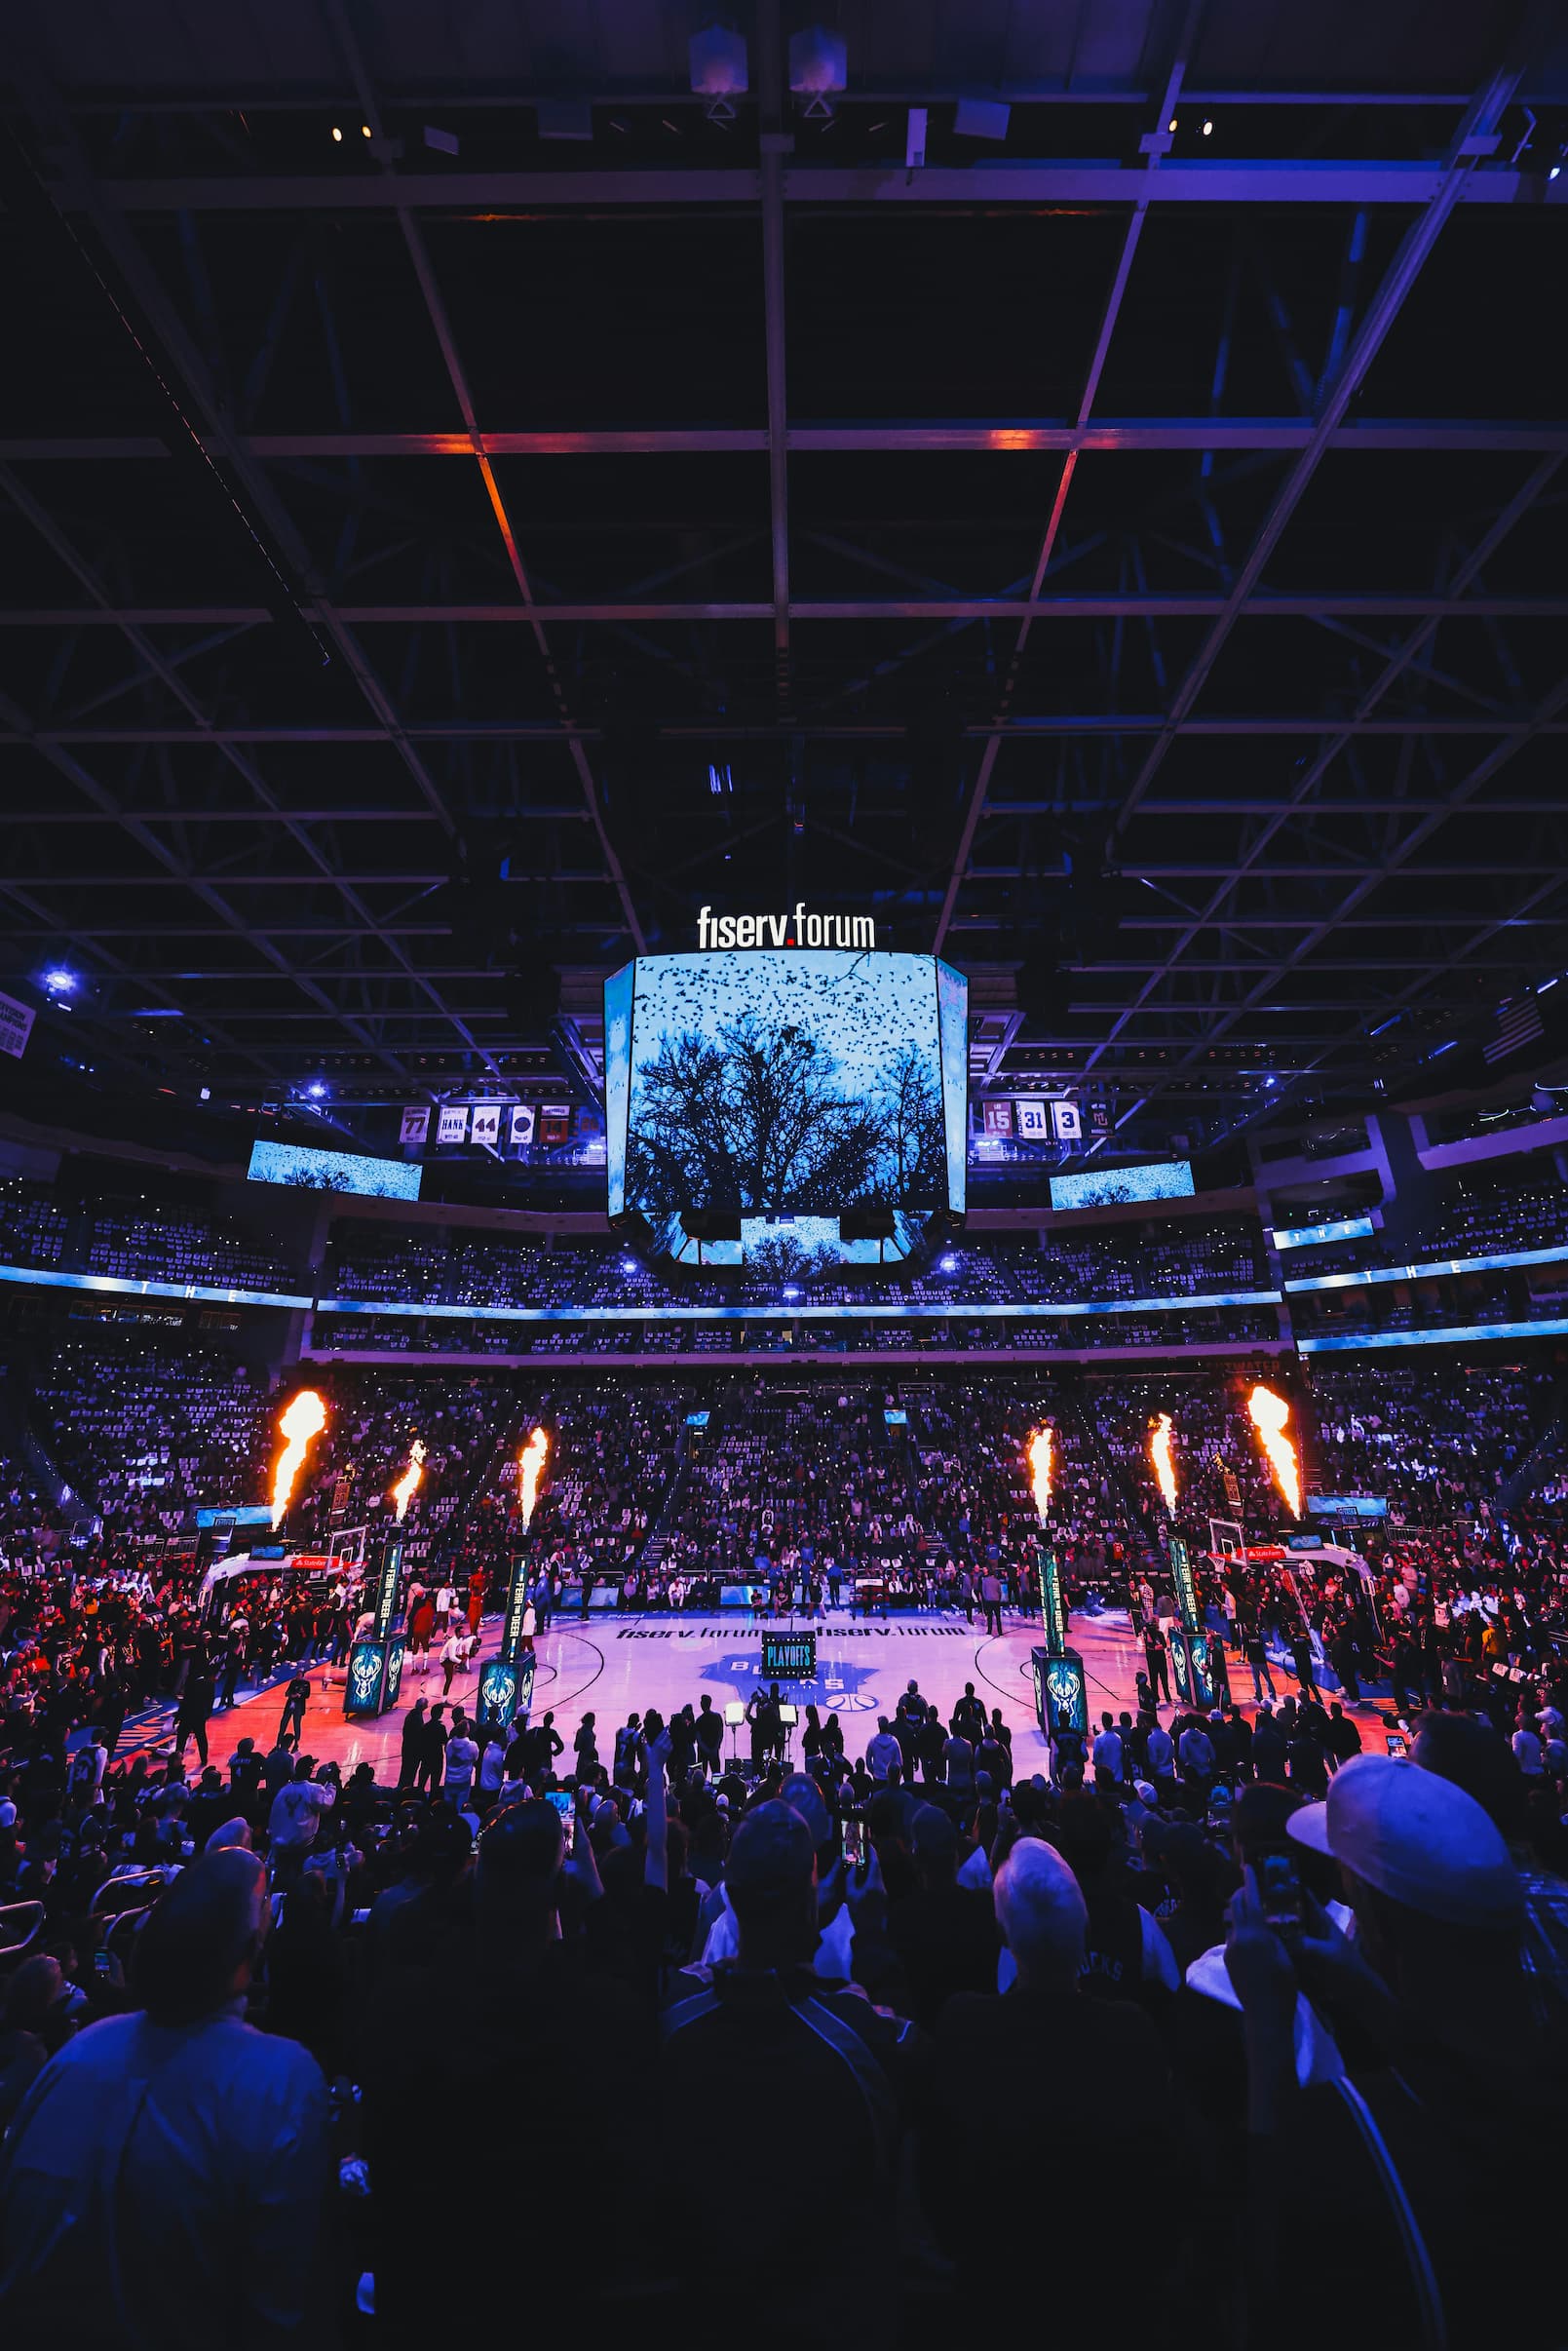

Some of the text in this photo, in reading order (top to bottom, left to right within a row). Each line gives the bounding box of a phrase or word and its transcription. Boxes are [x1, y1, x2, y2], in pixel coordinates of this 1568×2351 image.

[404, 1116, 426, 1135] 77
[475, 1118, 496, 1133] 44
[987, 1111, 1010, 1130] 15
[1024, 1111, 1043, 1129] 31
[1061, 1111, 1075, 1129] 3
[1364, 1260, 1462, 1284] THE
[140, 1280, 238, 1303] THE
[514, 1582, 525, 1604] FEAR
[1180, 1563, 1191, 1584] FEAR
[1186, 1593, 1197, 1613] DEER
[380, 1599, 392, 1619] DEER
[510, 1616, 521, 1638] DEER
[1055, 1610, 1064, 1632] DEER
[767, 1644, 811, 1667] PLAYOFFS
[1076, 1949, 1123, 1982] UCKS
